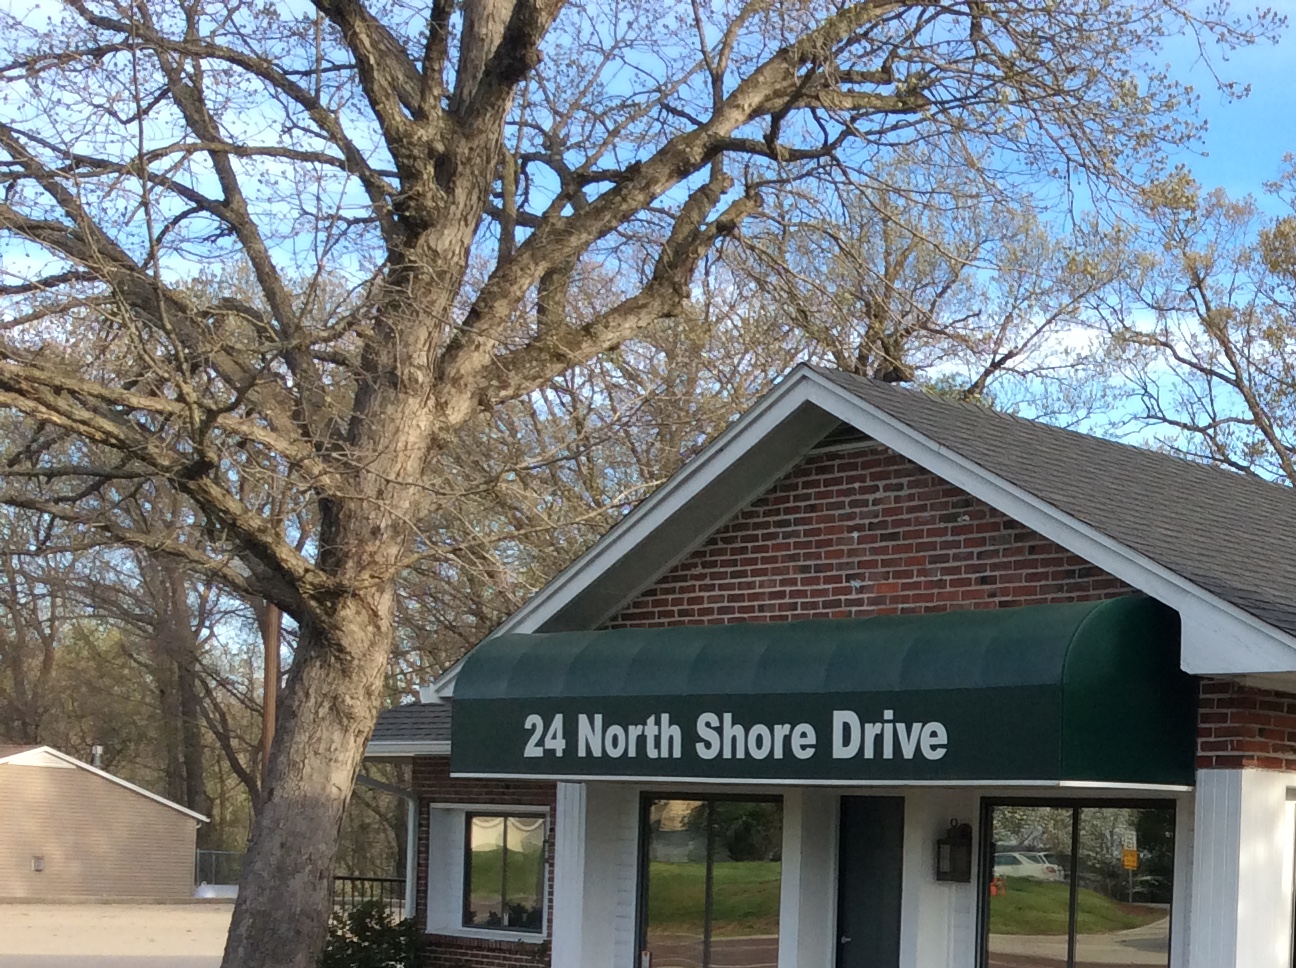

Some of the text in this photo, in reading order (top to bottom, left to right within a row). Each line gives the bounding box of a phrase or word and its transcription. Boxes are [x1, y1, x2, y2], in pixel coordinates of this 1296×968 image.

[523, 709, 948, 760] 24 North Shore Drive
